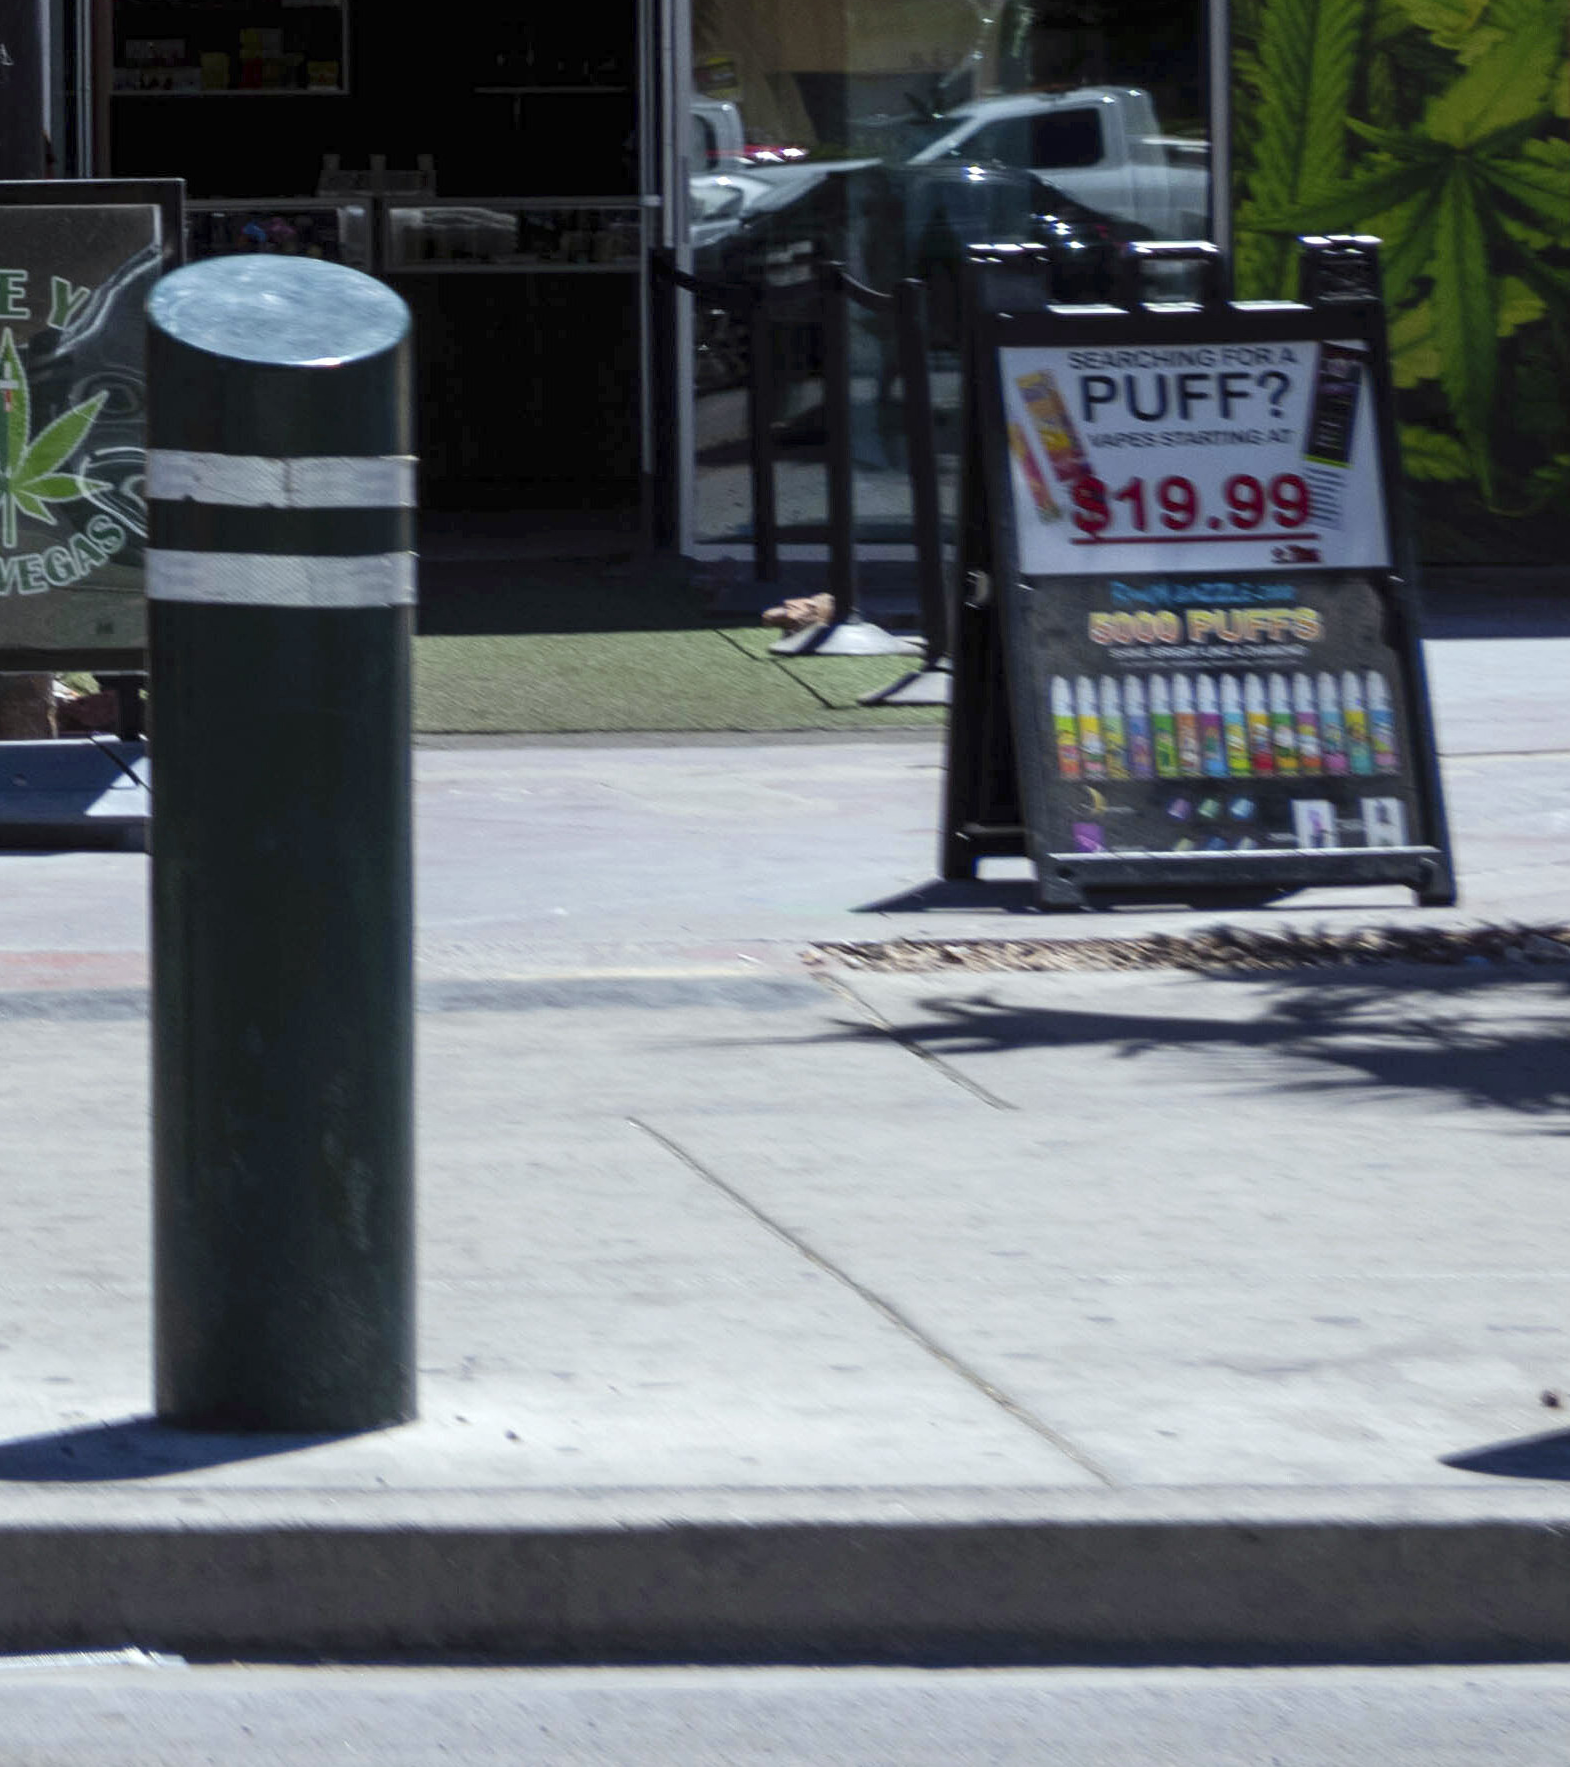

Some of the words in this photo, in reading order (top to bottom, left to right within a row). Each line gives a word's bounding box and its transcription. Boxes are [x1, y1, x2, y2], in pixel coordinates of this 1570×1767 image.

[1067, 348, 1216, 370] SEARCHING
[1221, 346, 1272, 367] FOR
[1279, 345, 1299, 365] A
[1078, 370, 1292, 423] PUFF?
[1089, 431, 1160, 448] VAPES
[1163, 429, 1263, 447] STARTING
[1070, 472, 1311, 538] $19.99
[1088, 610, 1184, 646] 5000
[1186, 606, 1325, 644] PUFFS
